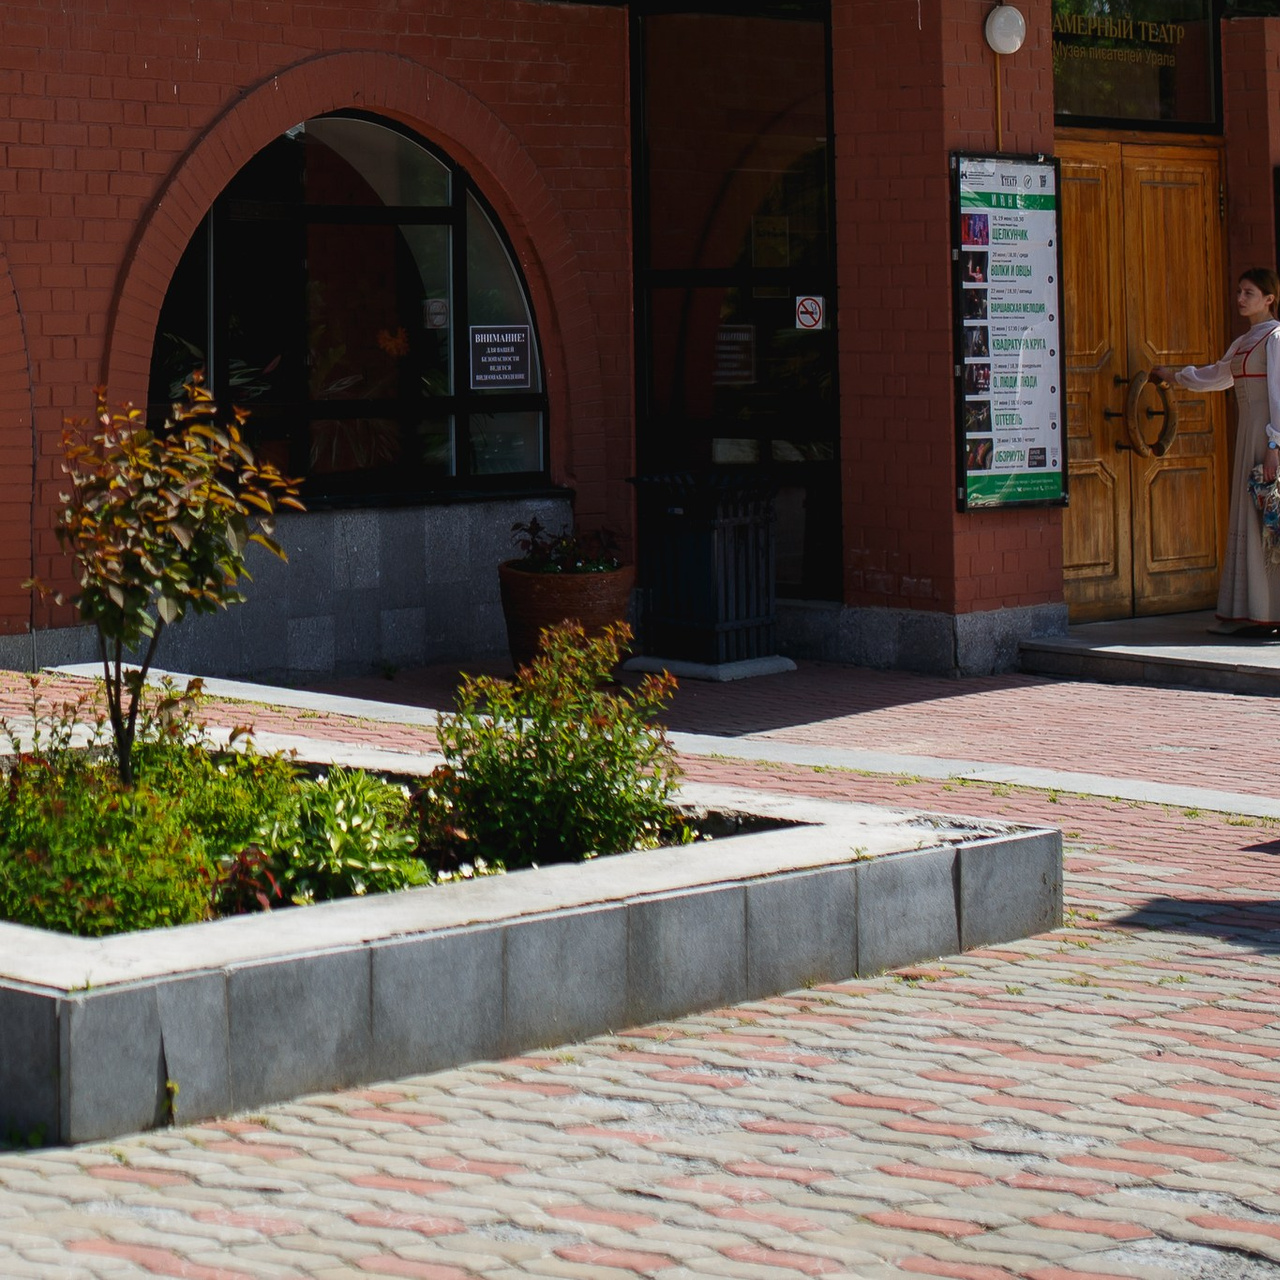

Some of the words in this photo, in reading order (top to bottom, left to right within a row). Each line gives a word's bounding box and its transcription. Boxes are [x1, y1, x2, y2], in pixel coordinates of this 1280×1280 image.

[1052, 12, 1134, 40] АМЕРНЫЙ
[1138, 20, 1186, 45] ТЕАТР
[1052, 39, 1087, 61] Музея
[1089, 46, 1143, 65] писателей
[1145, 48, 1177, 69] Урала
[992, 228, 1029, 241] ЩЕЛКУНЧИК
[990, 264, 1009, 277] ВОЛКИ
[1016, 265, 1032, 278] ОВЦЫ
[990, 302, 1022, 313] ВАРШАВСКАЯ
[1023, 303, 1046, 314] МЕЛОДИЯ
[475, 333, 525, 343] ВНИМАНИЕ!
[1029, 338, 1047, 350] КРУГА
[995, 413, 1023, 426] ОТТЕПЕЛЬ
